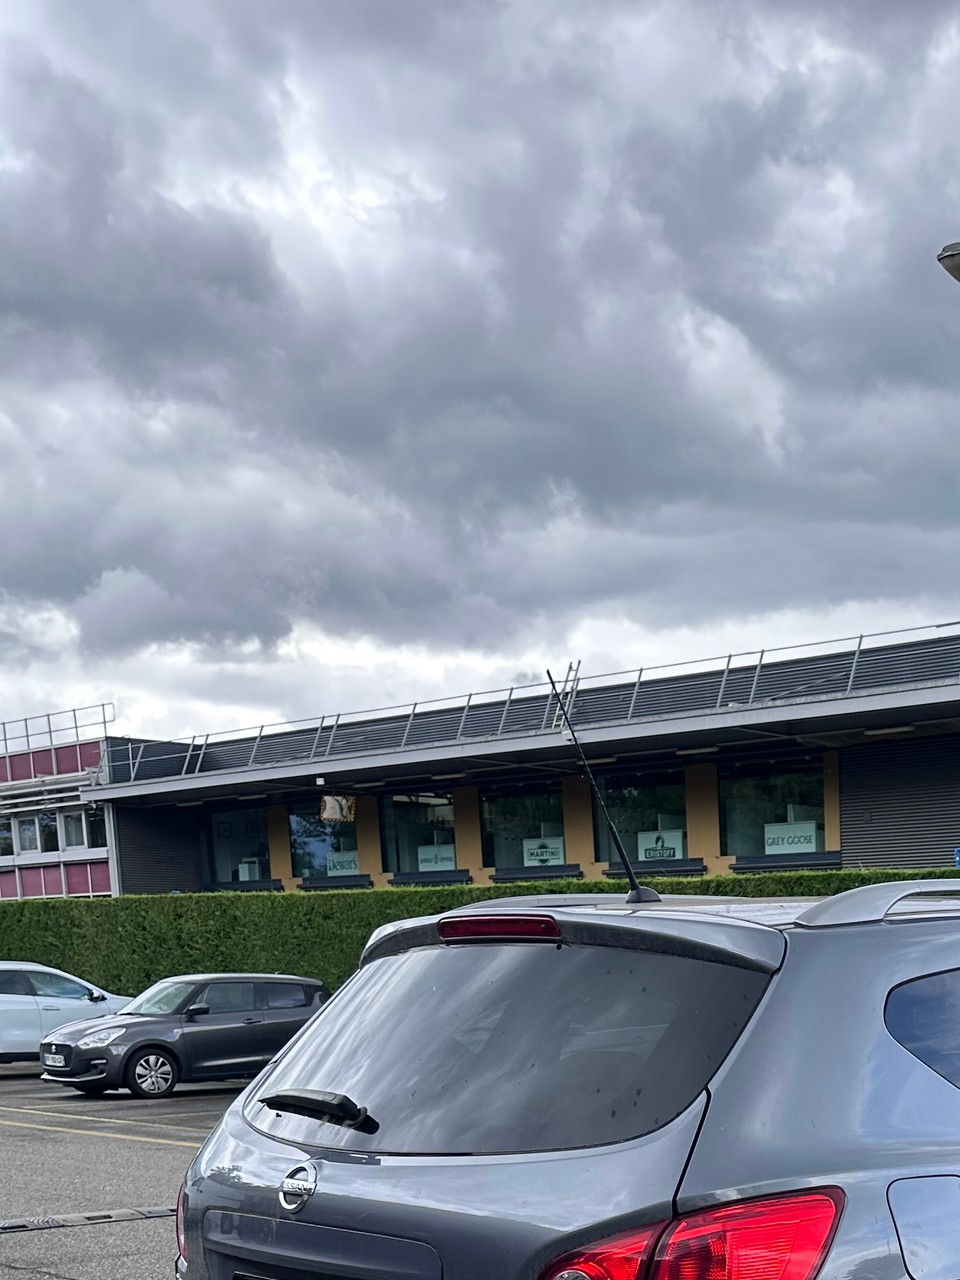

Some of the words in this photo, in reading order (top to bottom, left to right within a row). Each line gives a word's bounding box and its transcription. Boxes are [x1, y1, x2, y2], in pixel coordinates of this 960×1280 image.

[766, 836, 785, 847] GREY
[787, 834, 814, 845] GOOSE
[529, 850, 558, 858] MARTINI
